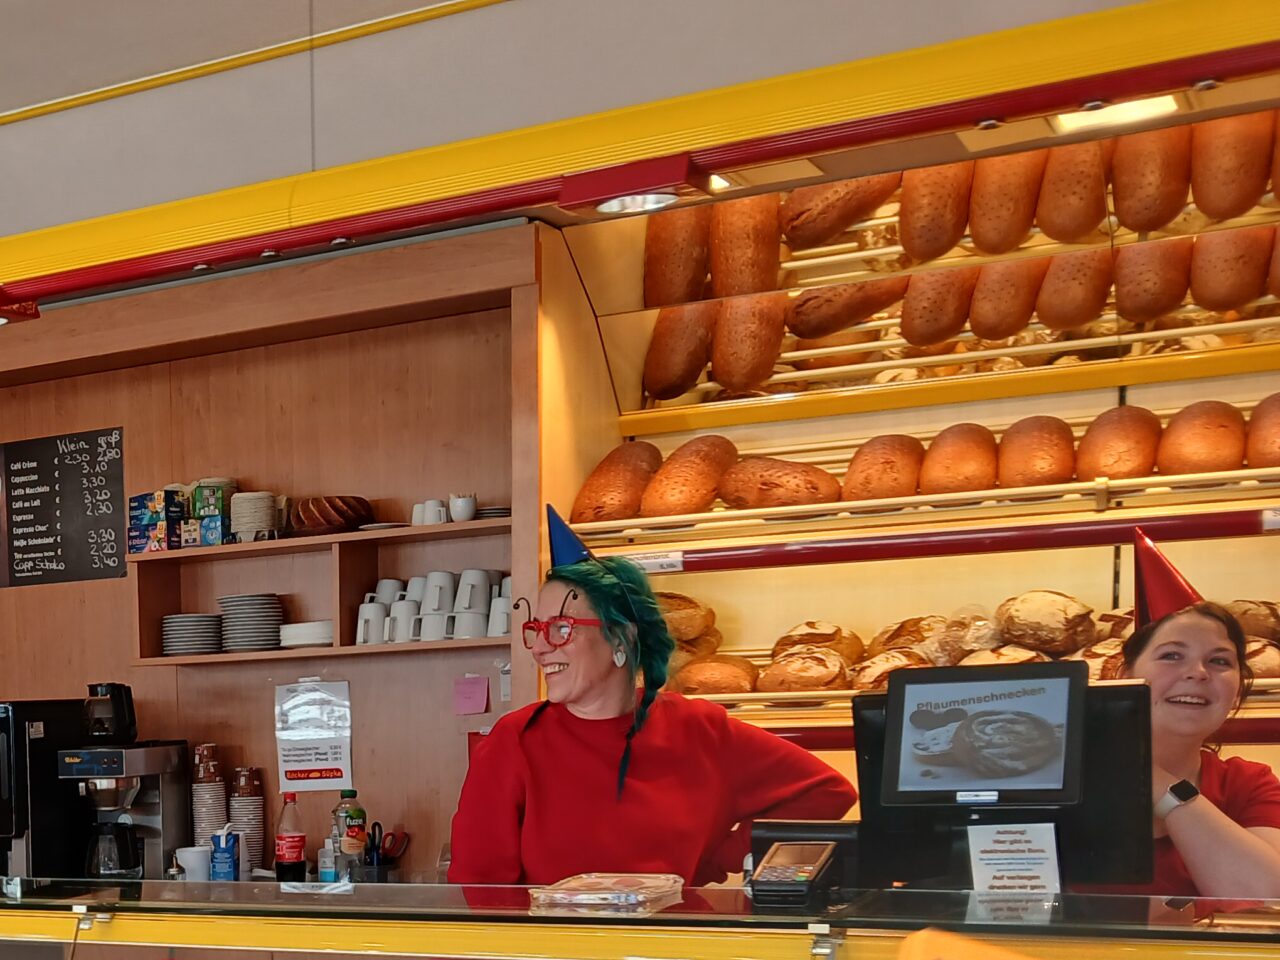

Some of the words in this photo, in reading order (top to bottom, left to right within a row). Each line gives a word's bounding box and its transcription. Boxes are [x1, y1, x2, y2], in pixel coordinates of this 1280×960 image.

[57, 438, 89, 454] Klein
[97, 430, 120, 451] groß
[64, 454, 90, 464] 2,30
[97, 448, 120, 462] 2,80
[81, 462, 108, 473] 3,10
[82, 476, 106, 488] 3,30
[82, 489, 111, 503] 3,20
[86, 501, 113, 516] 2,30
[88, 528, 116, 542] 3,30
[90, 542, 117, 556] 2,20
[92, 556, 118, 568] 3,40
[916, 686, 1046, 711] Pflaumenschnecken
